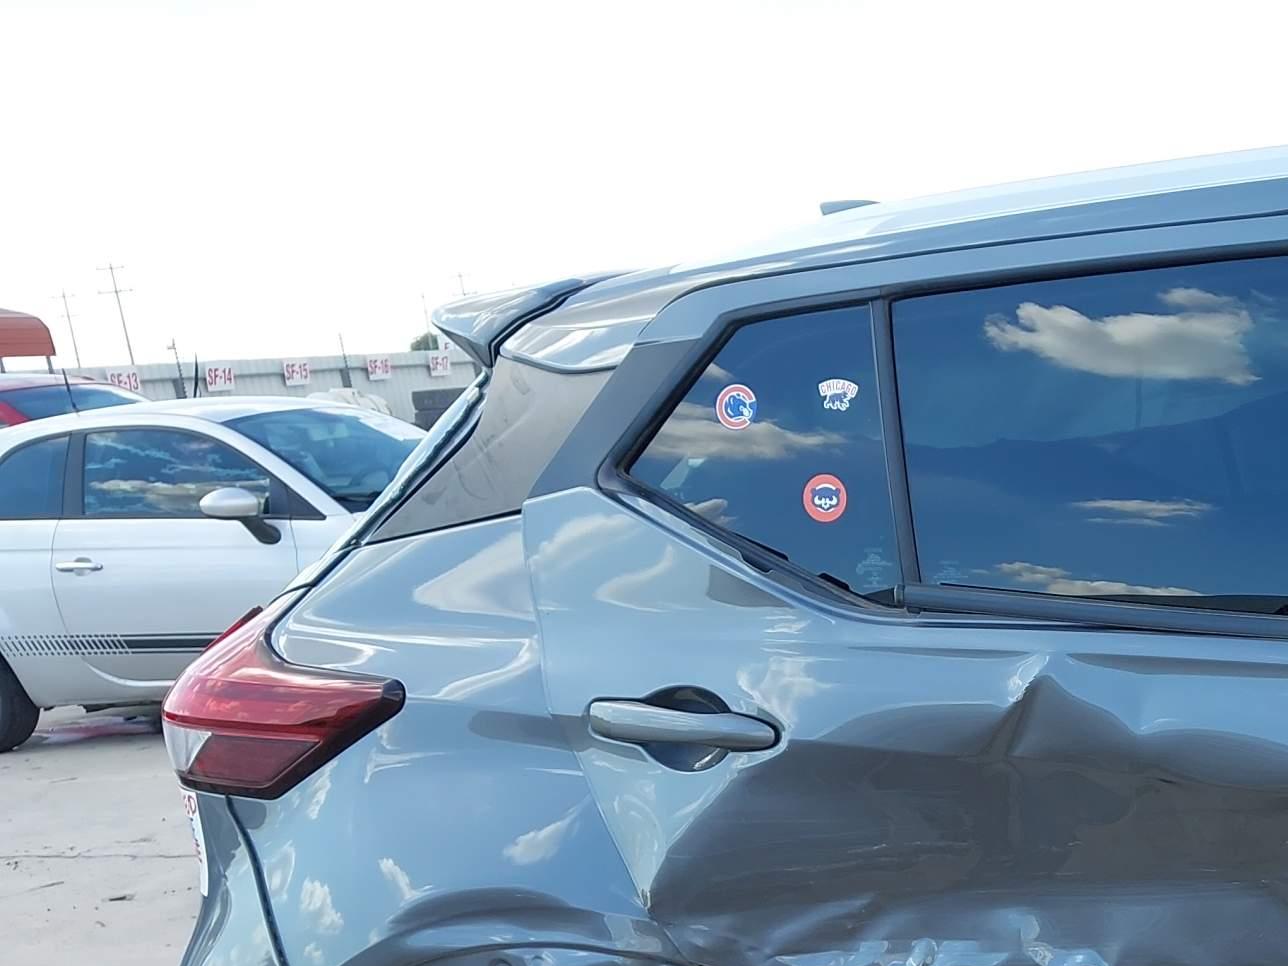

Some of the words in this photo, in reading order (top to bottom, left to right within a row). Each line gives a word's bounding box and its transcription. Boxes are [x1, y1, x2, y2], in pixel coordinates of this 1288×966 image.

[207, 367, 233, 386] SF-14
[285, 363, 309, 380] SF-15
[110, 372, 139, 391] SF-13
[820, 380, 857, 396] CHICAGO
